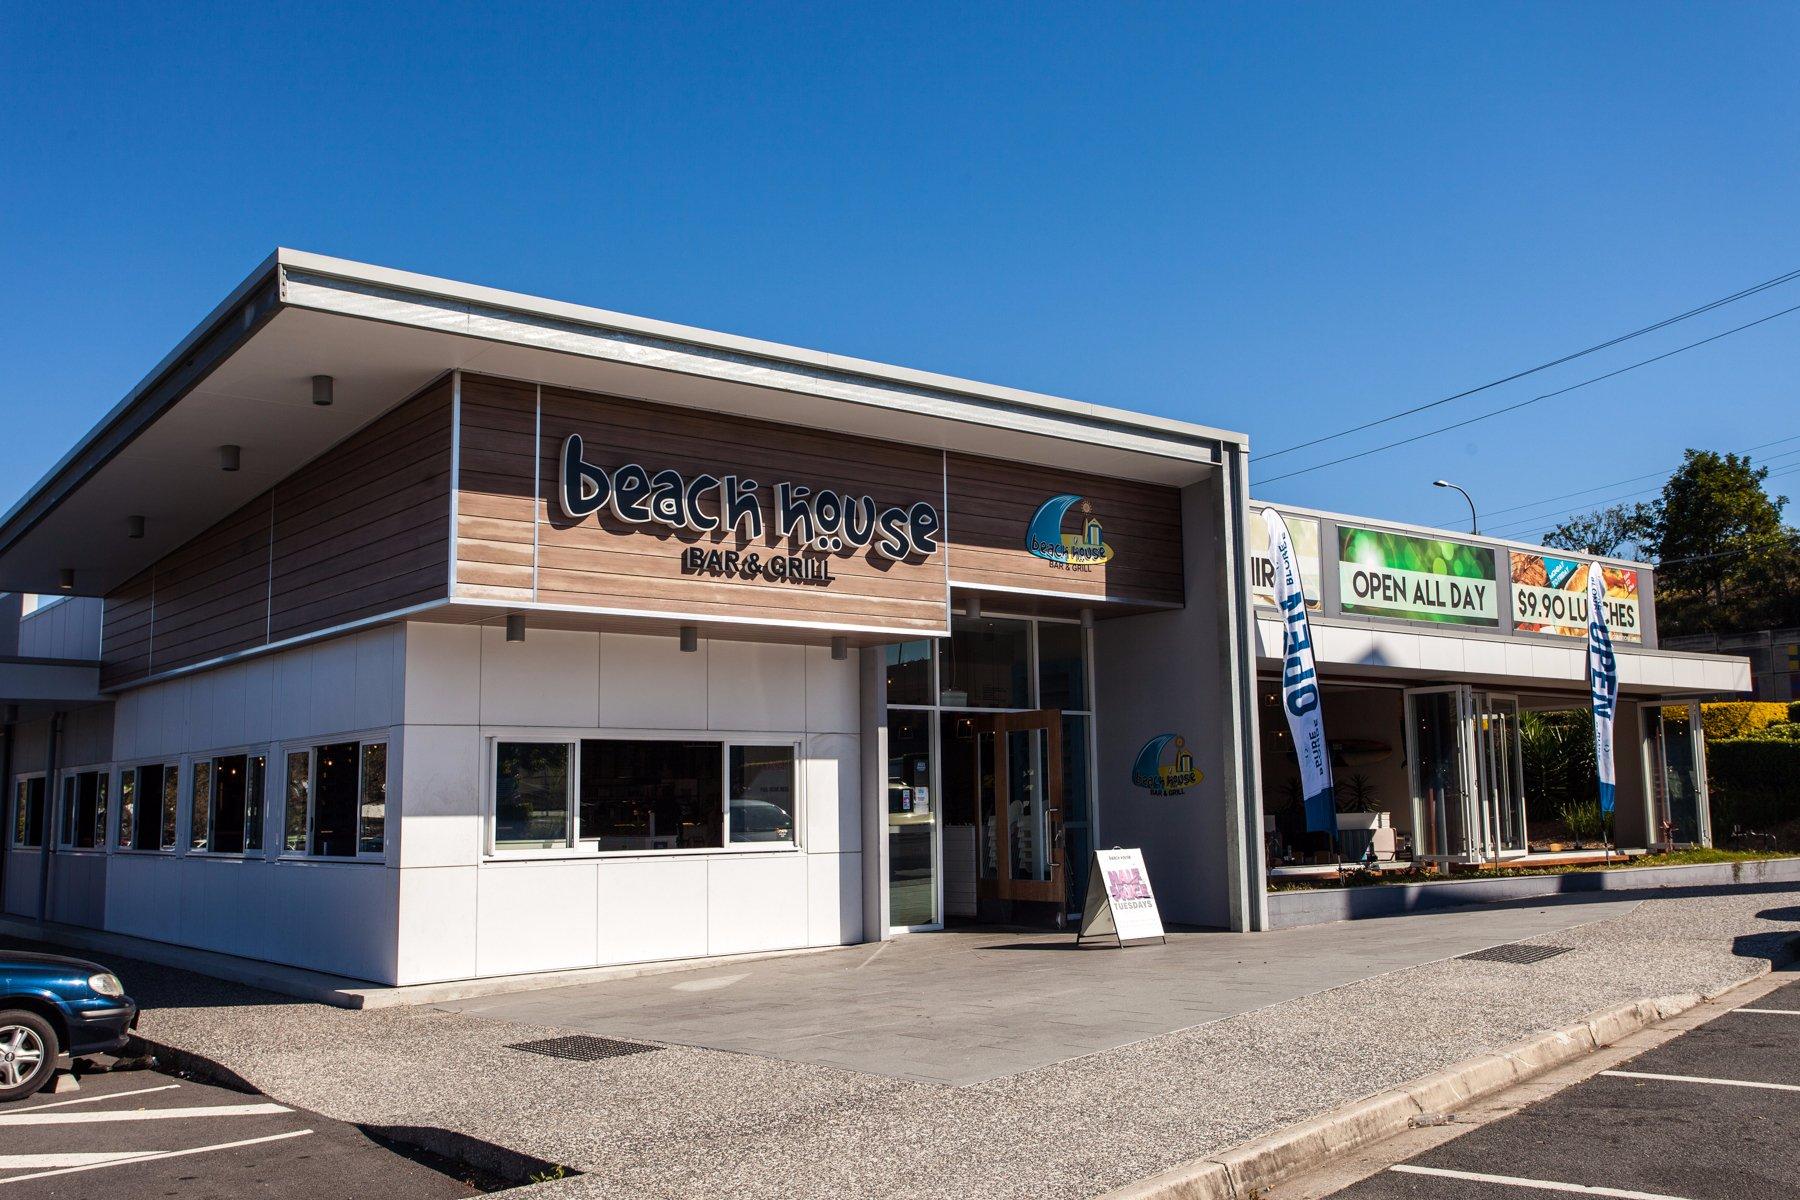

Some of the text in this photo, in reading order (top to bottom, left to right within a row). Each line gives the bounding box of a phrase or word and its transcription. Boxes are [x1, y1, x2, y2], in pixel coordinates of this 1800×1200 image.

[559, 433, 940, 561] beach house
[687, 546, 836, 581] BAR & GRILL
[1031, 533, 1106, 560] beach house
[1049, 560, 1064, 571] BAR
[1072, 564, 1092, 572] GRILL
[1352, 569, 1486, 612] OPEN ALL DAY
[1518, 588, 1565, 620] $9.90
[1568, 595, 1635, 628] LUCHES
[1279, 591, 1318, 717] OPEN
[1589, 621, 1617, 721] OPEN
[1114, 900, 1153, 911] TUESDAYS
